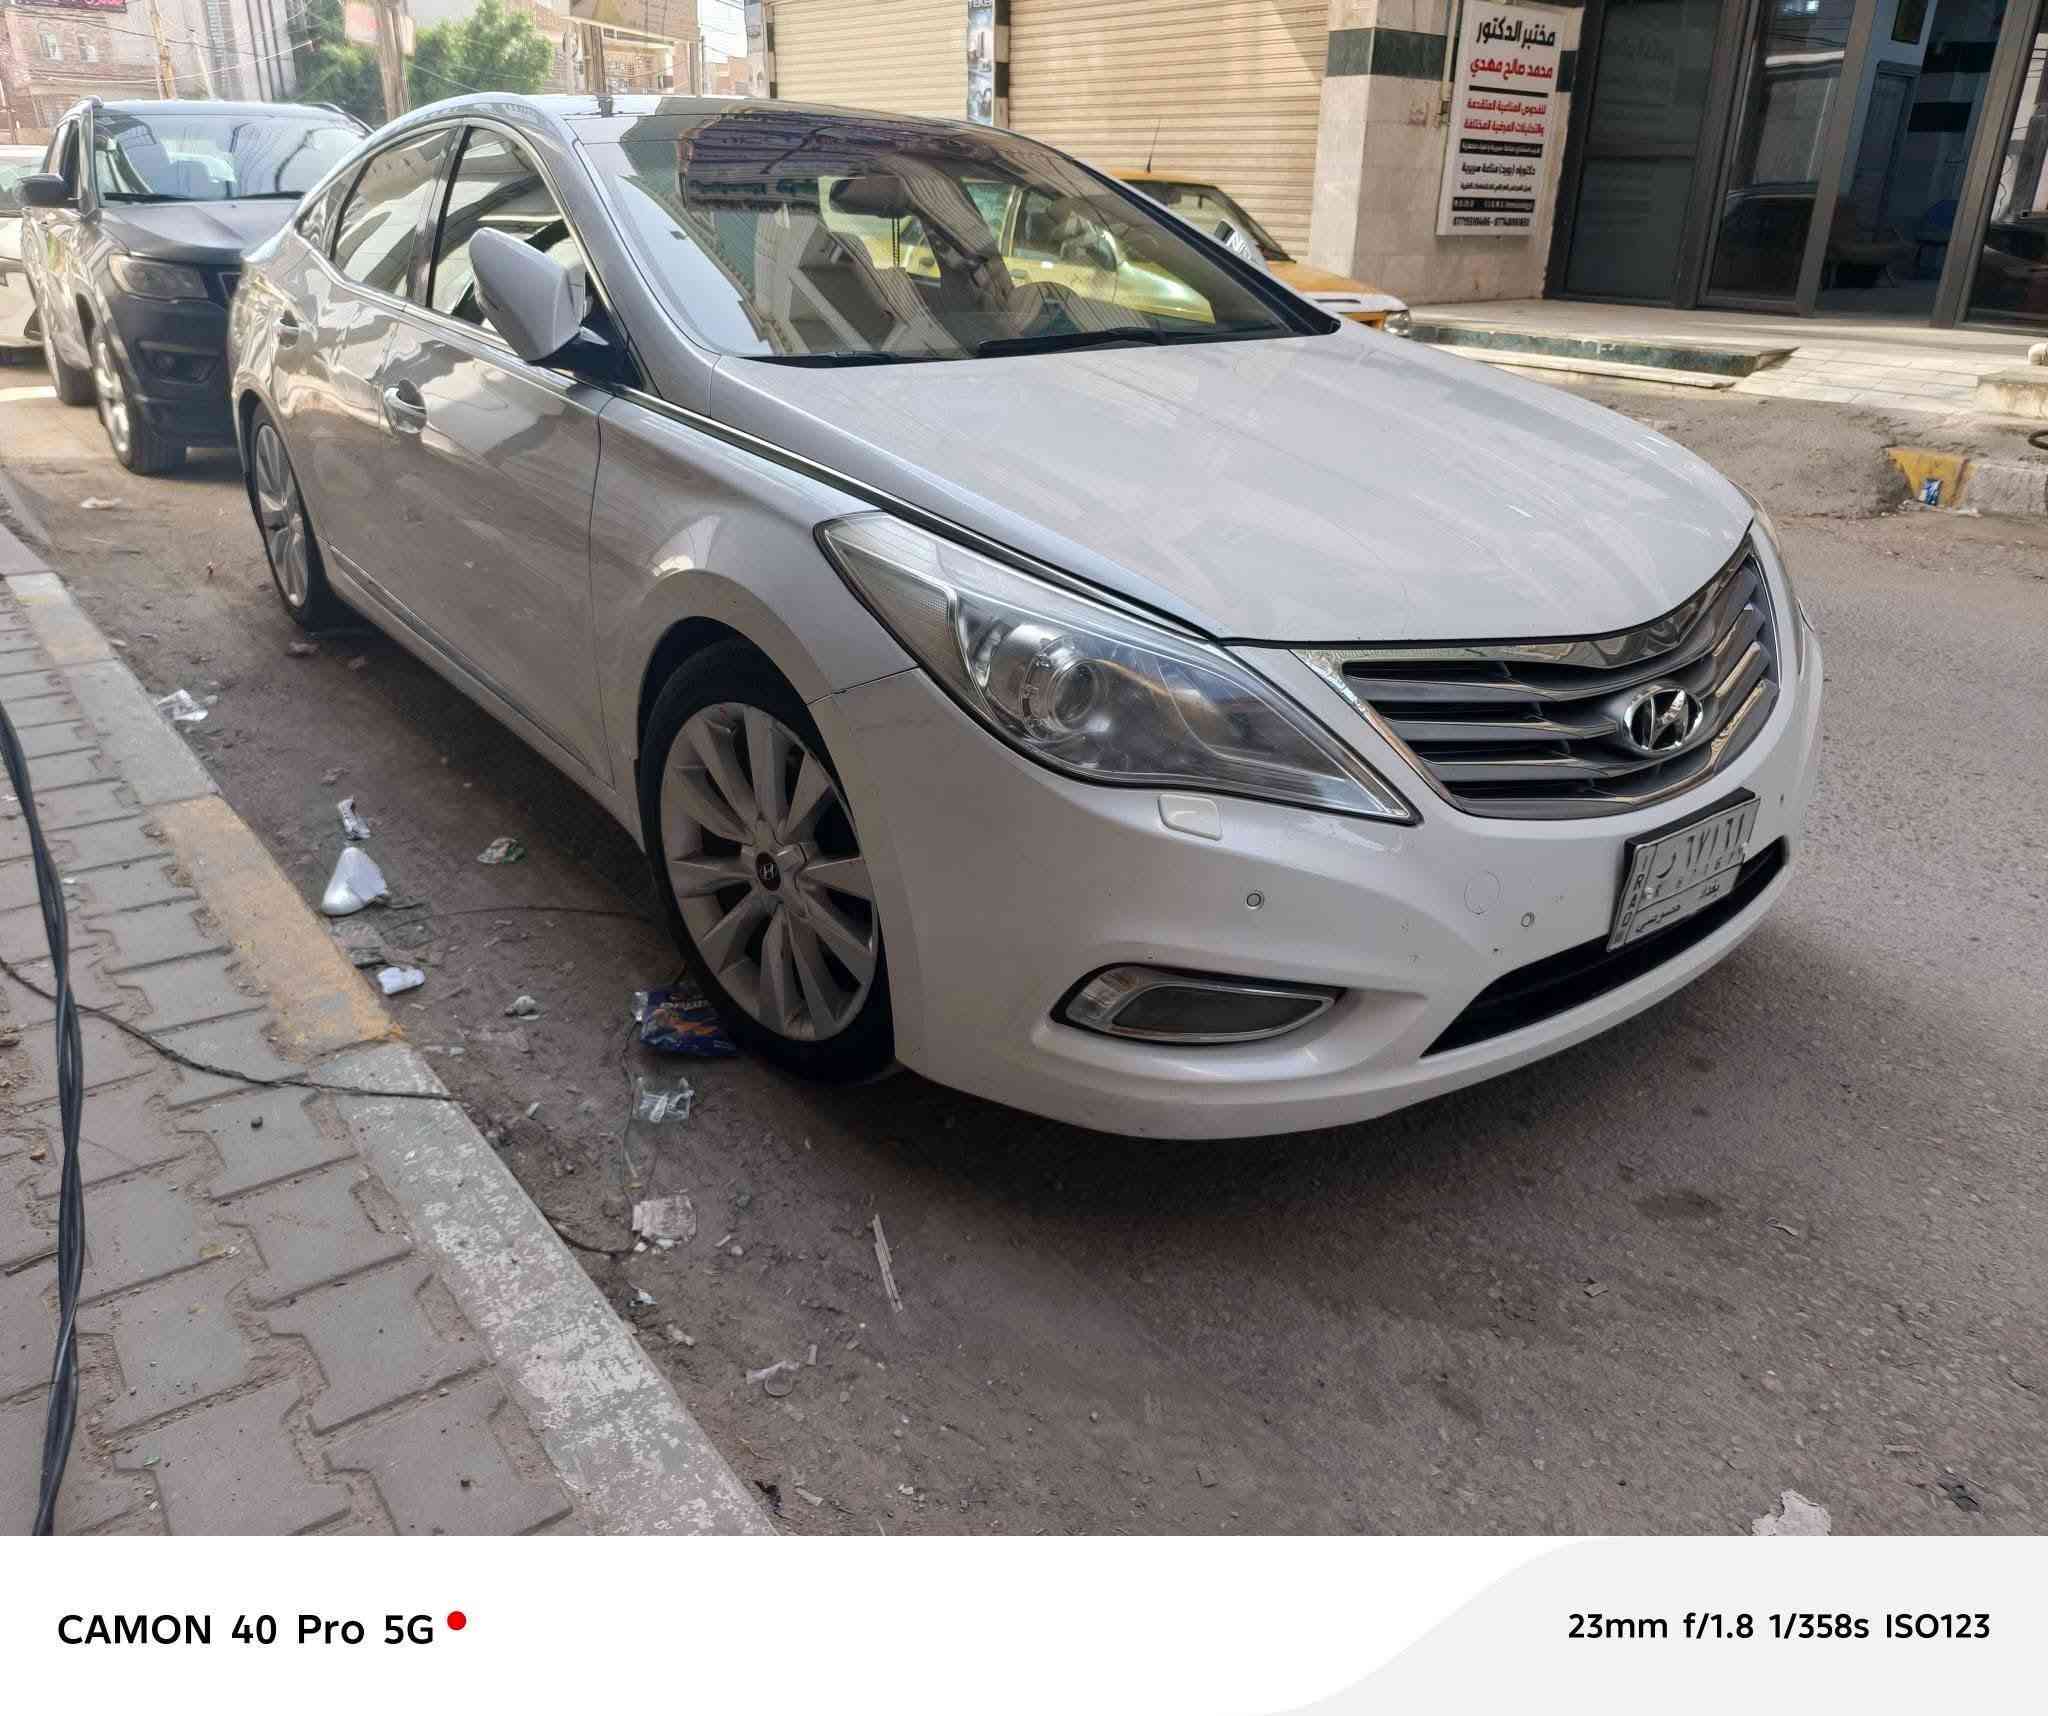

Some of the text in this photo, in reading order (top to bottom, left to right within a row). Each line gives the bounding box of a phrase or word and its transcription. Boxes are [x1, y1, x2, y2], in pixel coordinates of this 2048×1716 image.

[1476, 16, 1556, 49] مختبر الدكتور
[1470, 57, 1553, 80] محمد صالح مهدي
